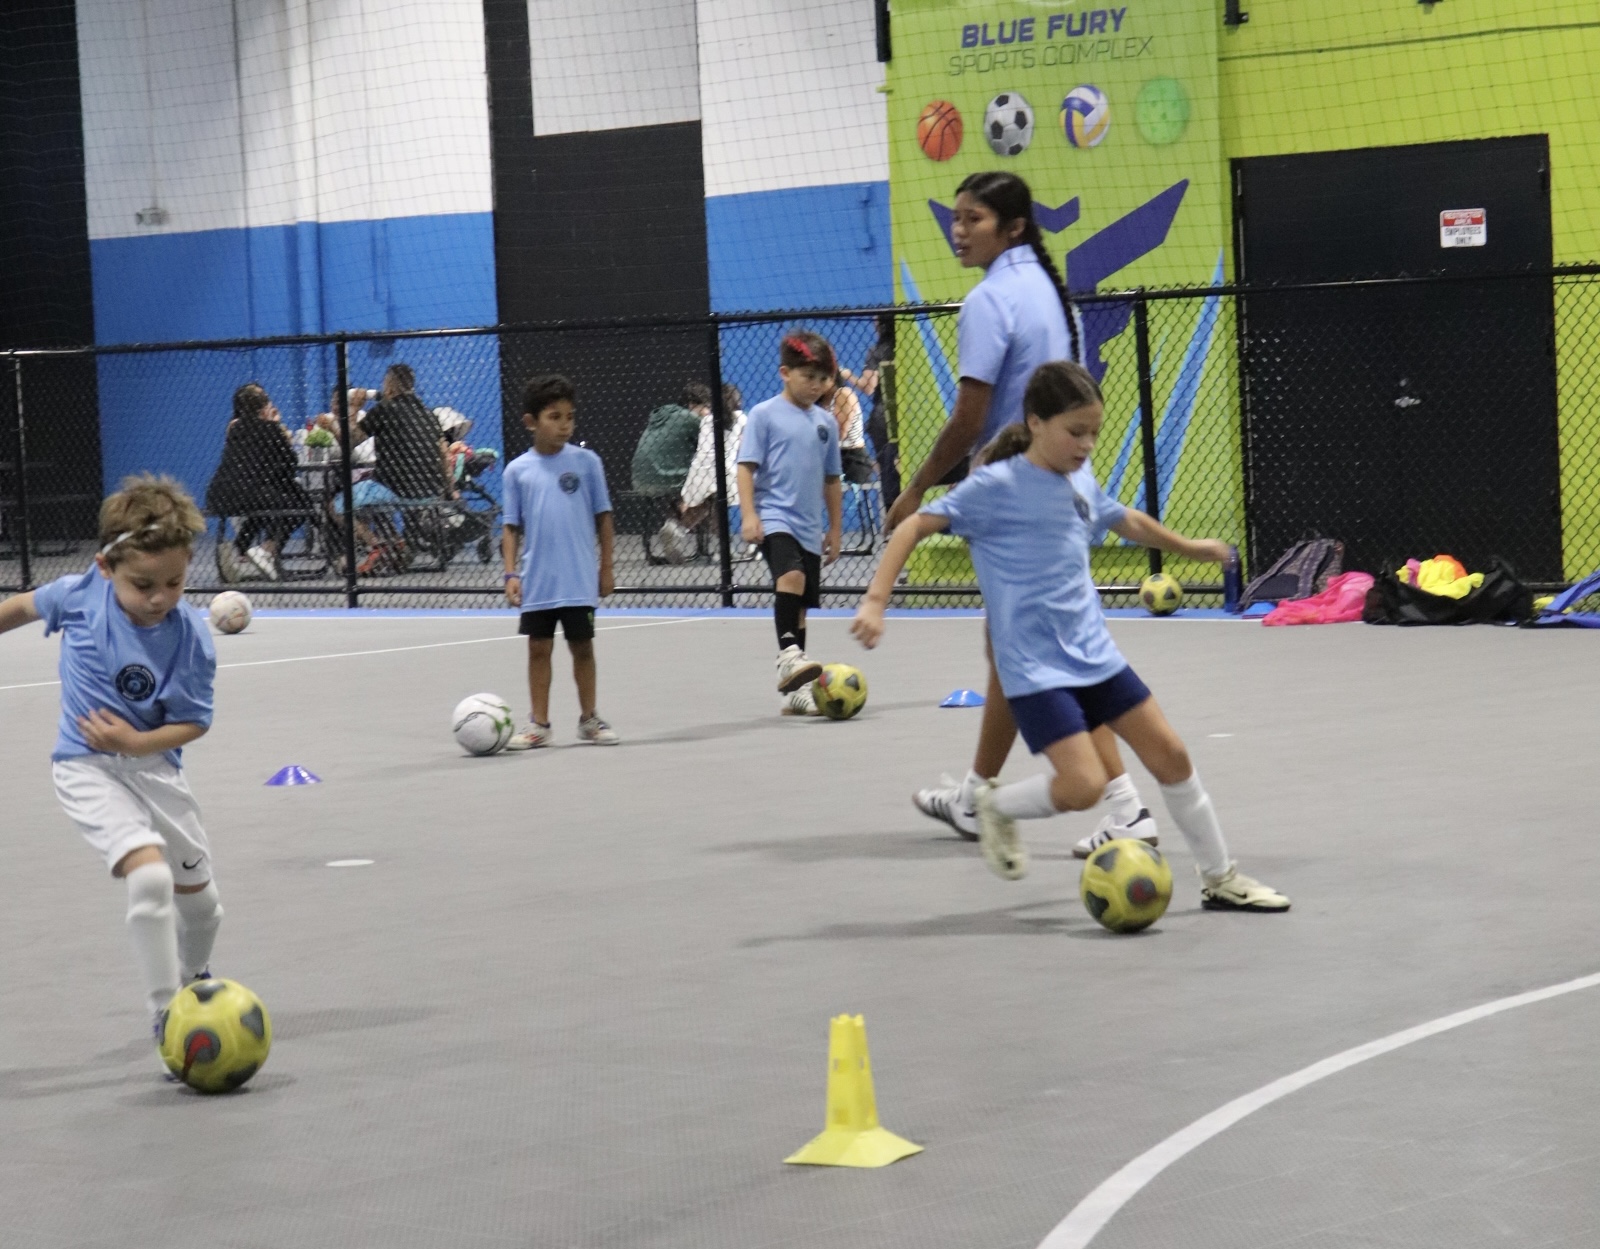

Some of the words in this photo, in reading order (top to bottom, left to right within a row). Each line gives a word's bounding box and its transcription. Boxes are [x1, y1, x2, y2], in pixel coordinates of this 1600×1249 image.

[962, 18, 1036, 48] BLUE
[1047, 8, 1127, 40] FURY
[949, 48, 1036, 76] SPORTS
[1042, 35, 1154, 66] COMPLEX
